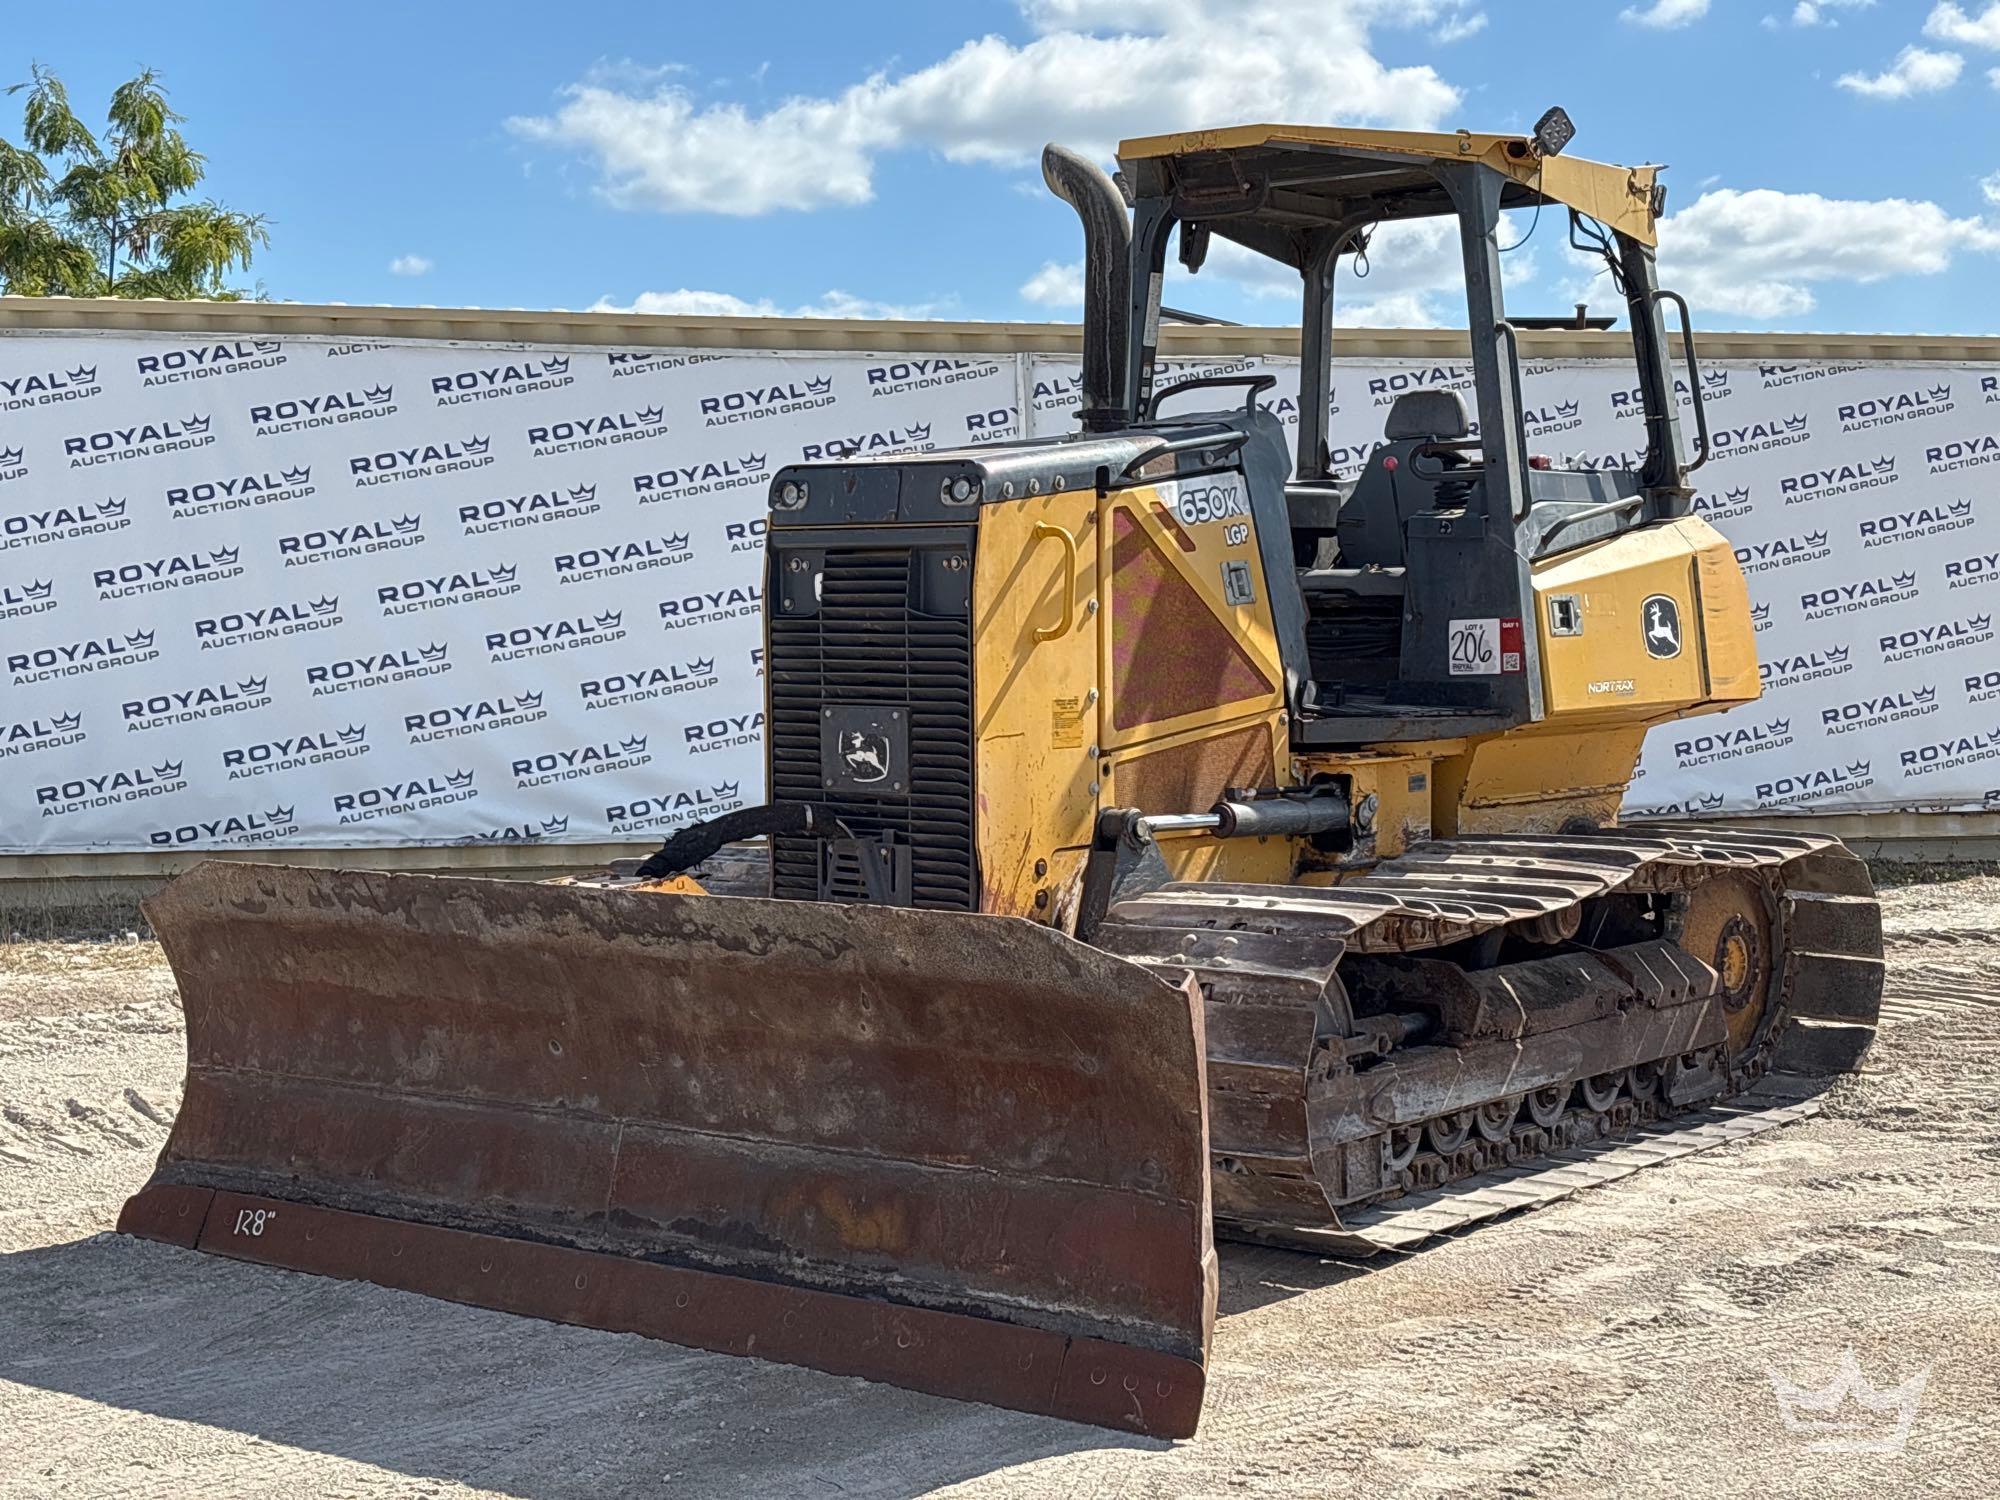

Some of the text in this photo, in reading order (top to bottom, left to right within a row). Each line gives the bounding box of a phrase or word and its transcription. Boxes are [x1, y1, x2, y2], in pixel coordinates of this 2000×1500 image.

[138, 341, 253, 374] ROYAL
[144, 356, 286, 387] AUCTION GROUP
[613, 358, 684, 377] AUCTION
[1204, 362, 1254, 378] GROUP
[432, 364, 542, 394] ROYAL
[438, 377, 574, 406] AUCTION GROUP
[872, 367, 998, 396] AUCTION GROUP
[1369, 366, 1464, 395] ROYAL
[1764, 369, 1825, 388] AUCTION
[39, 386, 101, 404] GROUP
[250, 392, 364, 424] ROYAL
[701, 384, 806, 414] ROYAL
[1044, 396, 1083, 409] GROU
[1838, 392, 1929, 421] ROYAL
[256, 406, 397, 436] AUCTION GROUP
[706, 397, 836, 427] AUCTION GROUP
[1533, 419, 1582, 436] GROUP
[1843, 403, 1954, 432] AUCTION GROUP
[64, 422, 182, 455] ROYAL
[528, 414, 637, 444] ROYAL
[534, 427, 668, 457] AUCTION GROUP
[70, 436, 215, 468] AUCTION GROUP
[350, 444, 462, 474] ROYAL
[802, 430, 906, 461] ROYAL
[1706, 433, 1810, 462] UCTION GROUP
[1926, 437, 1999, 463] ROYA
[356, 457, 494, 487] AUCTION GROUP
[634, 461, 740, 492] ROYAL
[1781, 464, 1872, 494] ROYAL
[1930, 455, 1990, 474] AUCTION
[167, 474, 282, 506] ROYAL
[173, 487, 315, 519] AUCTION GROUP
[639, 473, 770, 504] AUCTION GROUP
[1786, 474, 1898, 505] AUCTION GROUP
[3, 506, 97, 534] OYAL
[459, 492, 569, 523] ROYAL
[465, 504, 600, 535] AUCTION GROUP
[1178, 486, 1243, 525] 650K
[1703, 506, 1752, 522] GROUP
[0, 519, 130, 550] UCTION GROUP
[1223, 522, 1248, 547] LGP
[1860, 507, 1948, 537] ROYAL
[1864, 518, 1974, 548] AUCTION GROUP
[279, 522, 392, 554] ROYAL
[285, 535, 424, 567] AUCTION GROUP
[1734, 538, 1804, 564] OYAL
[94, 554, 210, 588] ROYAL
[555, 540, 662, 572] ROYAL
[560, 553, 693, 584] AUCTION GROUP
[1782, 549, 1830, 566] GROUP
[100, 567, 244, 600] AUCTION GROUP
[378, 572, 489, 604] ROYAL
[1801, 579, 1893, 609] ROYAL
[1950, 572, 1998, 589] AUCTIO
[384, 585, 520, 616] AUCTION GROUP
[1806, 590, 1918, 620] AUCTION GROUP
[195, 604, 310, 637] ROYAL
[202, 617, 342, 650] AUCTION GROUP
[486, 618, 595, 650] ROYAL
[665, 609, 736, 630] AUCTION
[492, 630, 626, 663] AUCTION GROUP
[1451, 630, 1492, 663] 206
[1880, 622, 1968, 652] ROYAL
[1884, 632, 1994, 663] AUCTION GROUP
[8, 638, 126, 672] ROYAL
[14, 650, 159, 686] AUCTION GROUP
[307, 651, 419, 684] ROYAL
[1758, 654, 1825, 679] OYAL
[313, 663, 451, 696] AUCTION GROUP
[580, 666, 688, 698] ROYAL
[1588, 680, 1634, 694] NORTRAX
[1803, 664, 1852, 681] GROUP
[122, 685, 238, 719] ROYAL
[586, 678, 718, 710] AUCTION GROUP
[1822, 694, 1913, 724] ROYAL
[128, 697, 271, 732] AUCTION GROUP
[405, 699, 515, 732] ROYAL
[410, 711, 547, 744] AUCTION GROUP
[684, 713, 765, 742] ROYA
[1827, 704, 1938, 736] AUCTION GROUP
[23, 733, 86, 752] GROUP
[223, 733, 338, 767] ROYAL
[690, 733, 760, 754] AUCTION
[1674, 726, 1767, 757] ROYAL
[1679, 737, 1793, 768] AUCTION GROUP
[1900, 736, 1988, 766] ROYAL
[229, 745, 370, 780] AUCTION GROUP
[512, 744, 620, 776] ROYAL
[518, 755, 651, 789] AUCTION GROUP
[1904, 757, 1964, 777] AUCTION
[36, 770, 154, 804] ROYAL
[42, 781, 187, 817] AUCTION GROUP
[334, 778, 446, 812] ROYAL
[1756, 768, 1848, 799] ROYAL
[1825, 779, 1873, 796] GROUP
[340, 790, 478, 825] AUCTION GROUP
[606, 790, 712, 822] ROYAL
[150, 814, 266, 844] ROYAL
[612, 813, 683, 834] AUCTION
